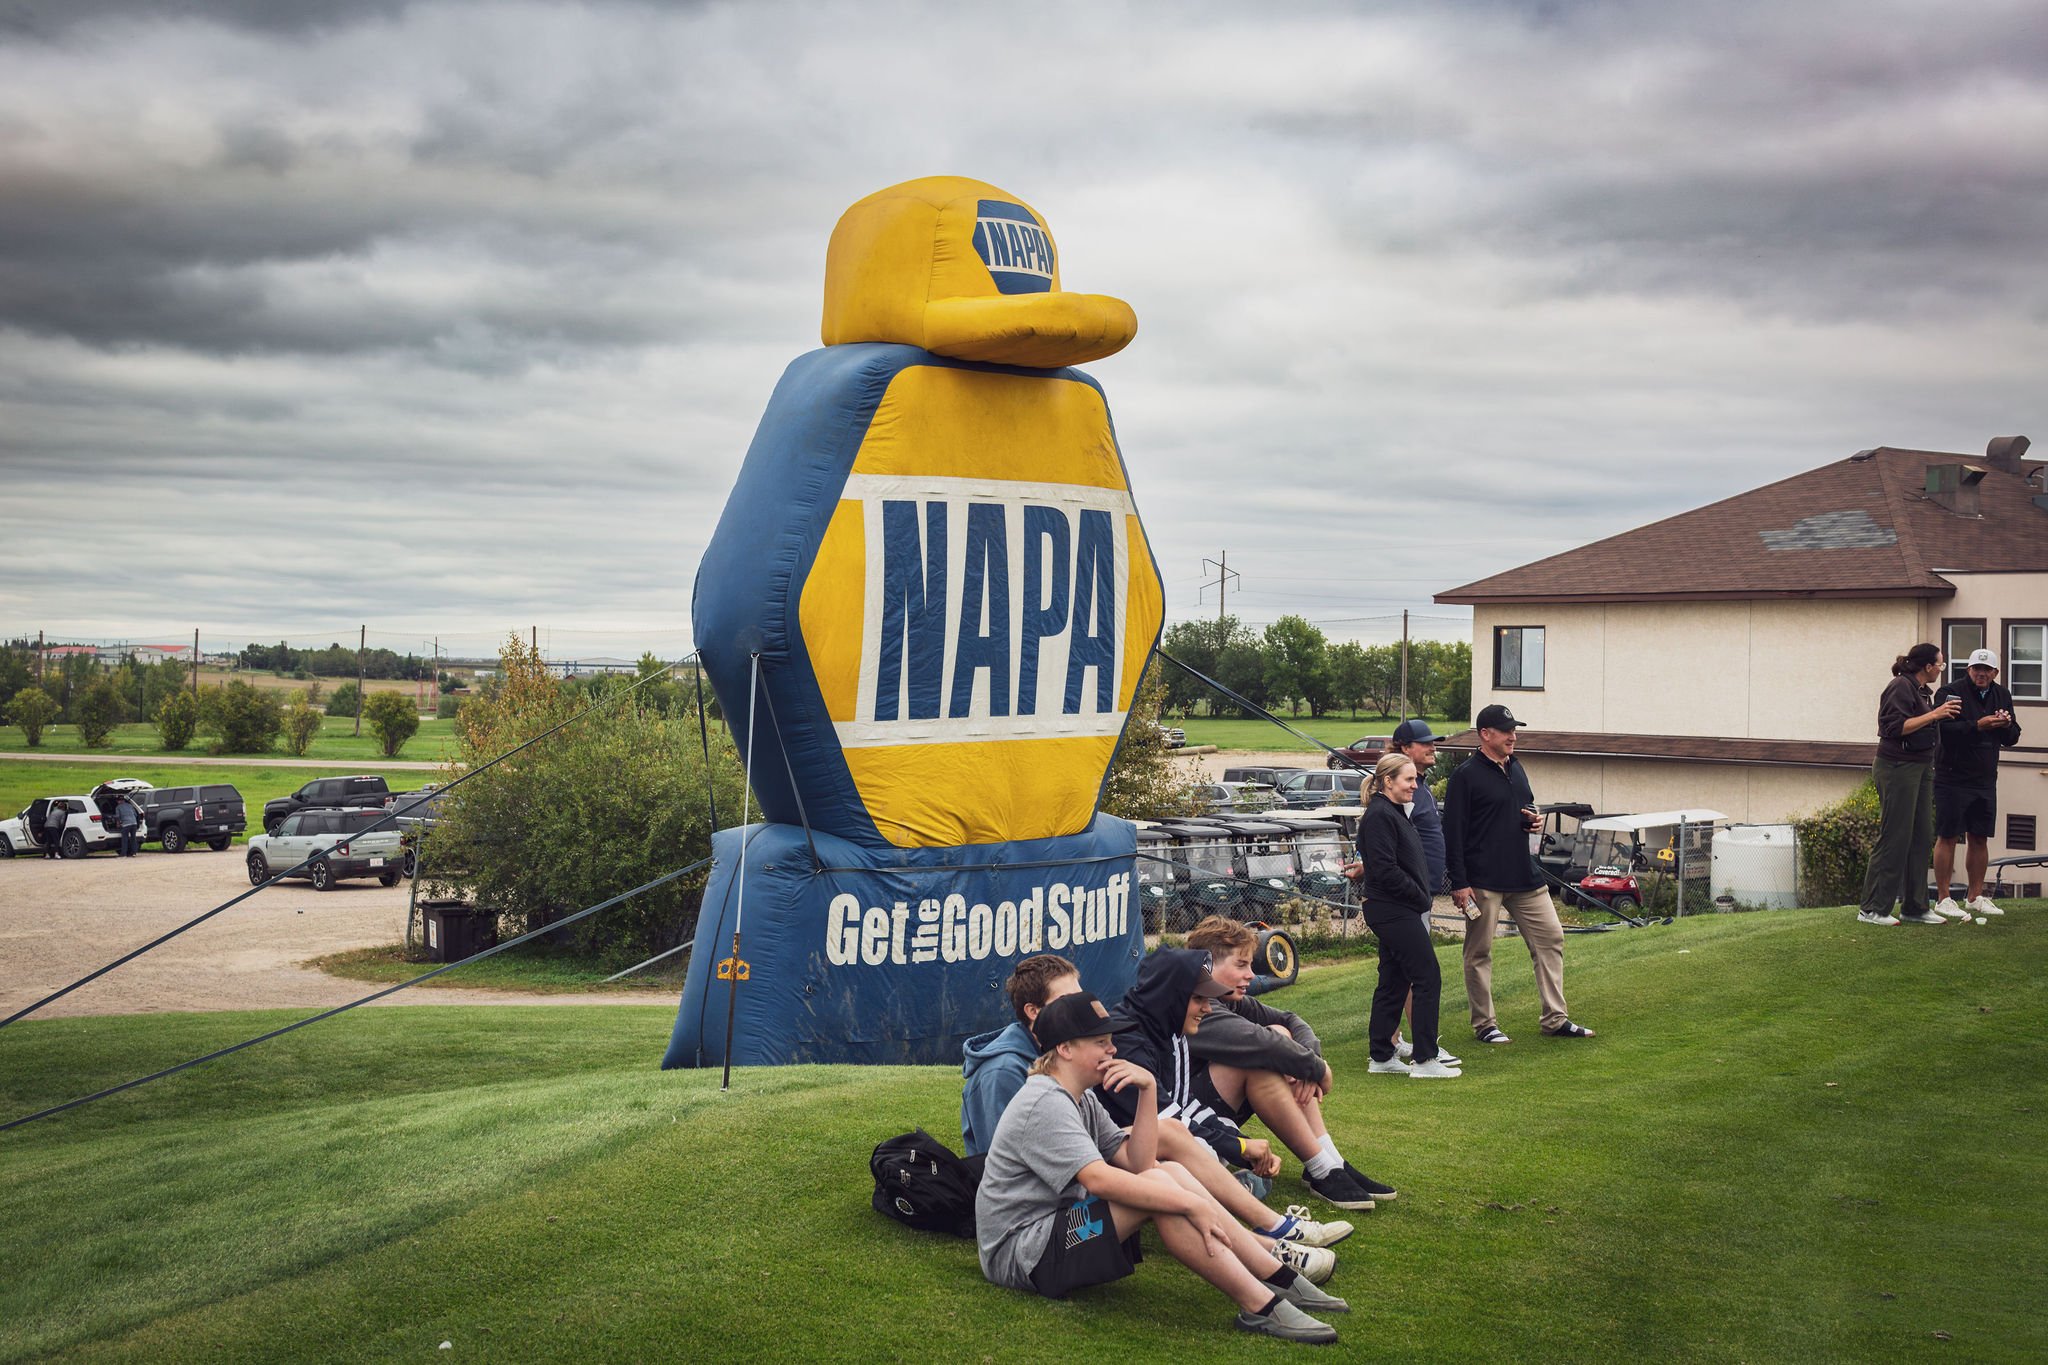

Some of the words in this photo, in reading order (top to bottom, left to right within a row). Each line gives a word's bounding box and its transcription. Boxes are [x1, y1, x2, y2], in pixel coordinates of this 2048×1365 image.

[985, 221, 1050, 275] NAPA
[874, 500, 1116, 722] NAPA
[826, 893, 910, 966] Get
[912, 898, 942, 964] the
[941, 886, 1044, 963] Good
[1048, 871, 1130, 951] Stuff
